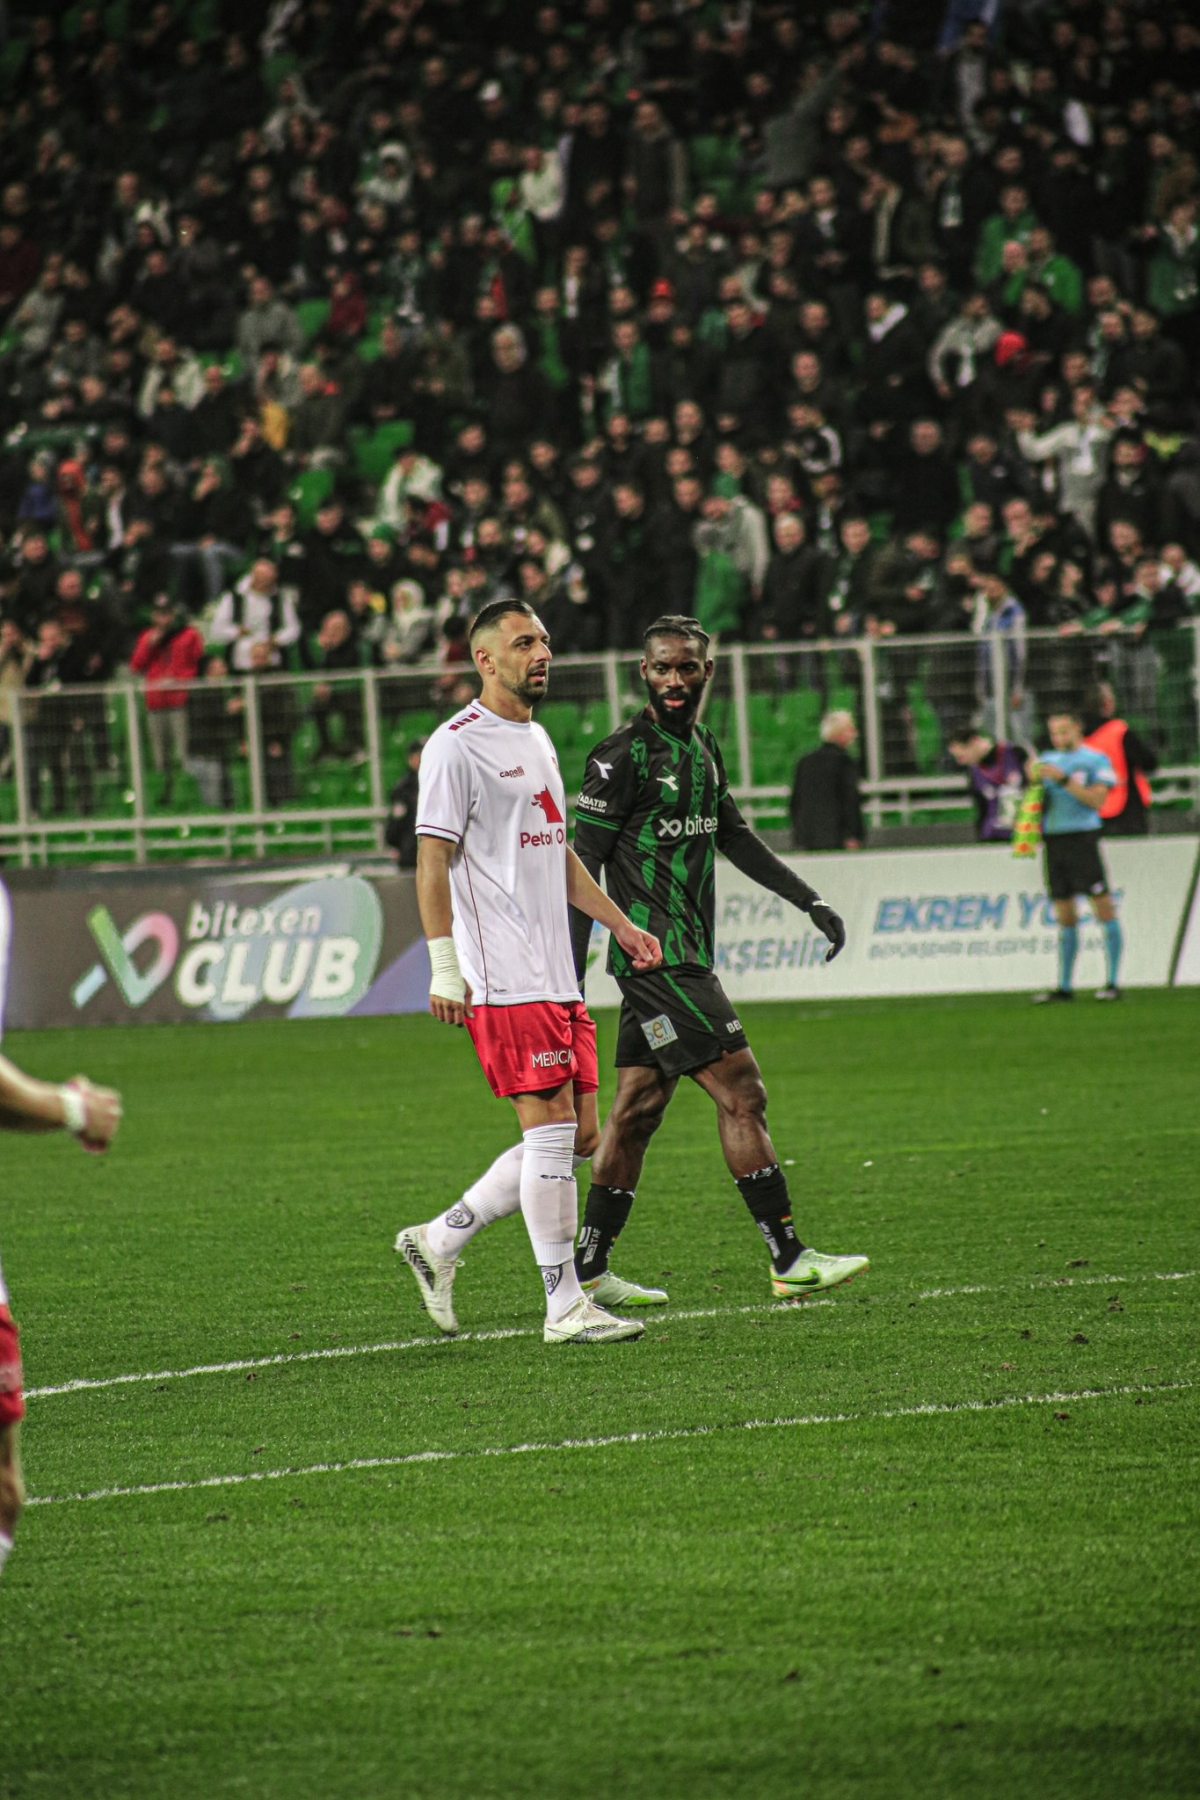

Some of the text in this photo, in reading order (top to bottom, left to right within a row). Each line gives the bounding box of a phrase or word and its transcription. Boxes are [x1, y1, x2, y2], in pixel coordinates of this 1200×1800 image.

[499, 765, 525, 779] capelli
[188, 901, 323, 939] bitexen
[717, 895, 783, 924] RYA
[874, 894, 1008, 933] EKREM
[176, 936, 361, 1006] CLUB
